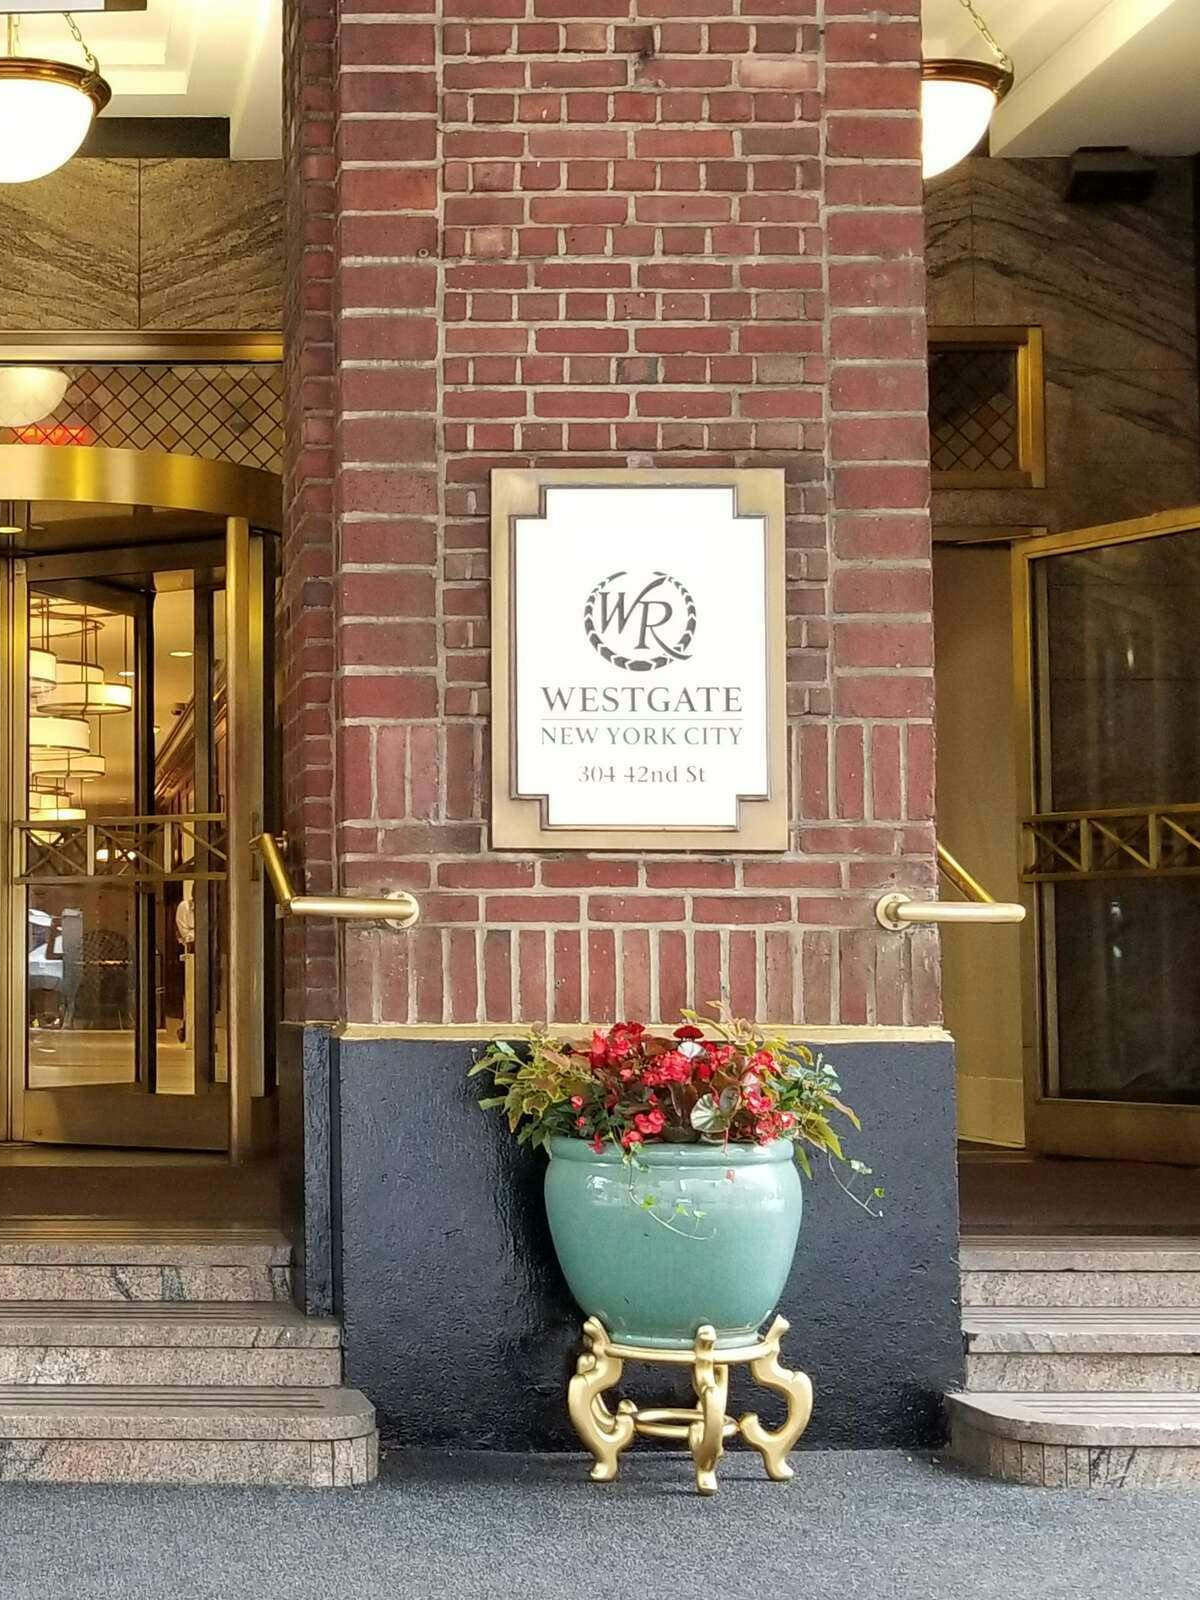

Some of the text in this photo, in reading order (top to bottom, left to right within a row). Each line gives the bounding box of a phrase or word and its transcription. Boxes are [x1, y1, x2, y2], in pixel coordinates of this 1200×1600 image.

[599, 575, 694, 660] WR
[540, 686, 743, 713] WESTGATE
[541, 726, 743, 746] NEW YORK CITY
[578, 764, 706, 783] 304 42nd St
